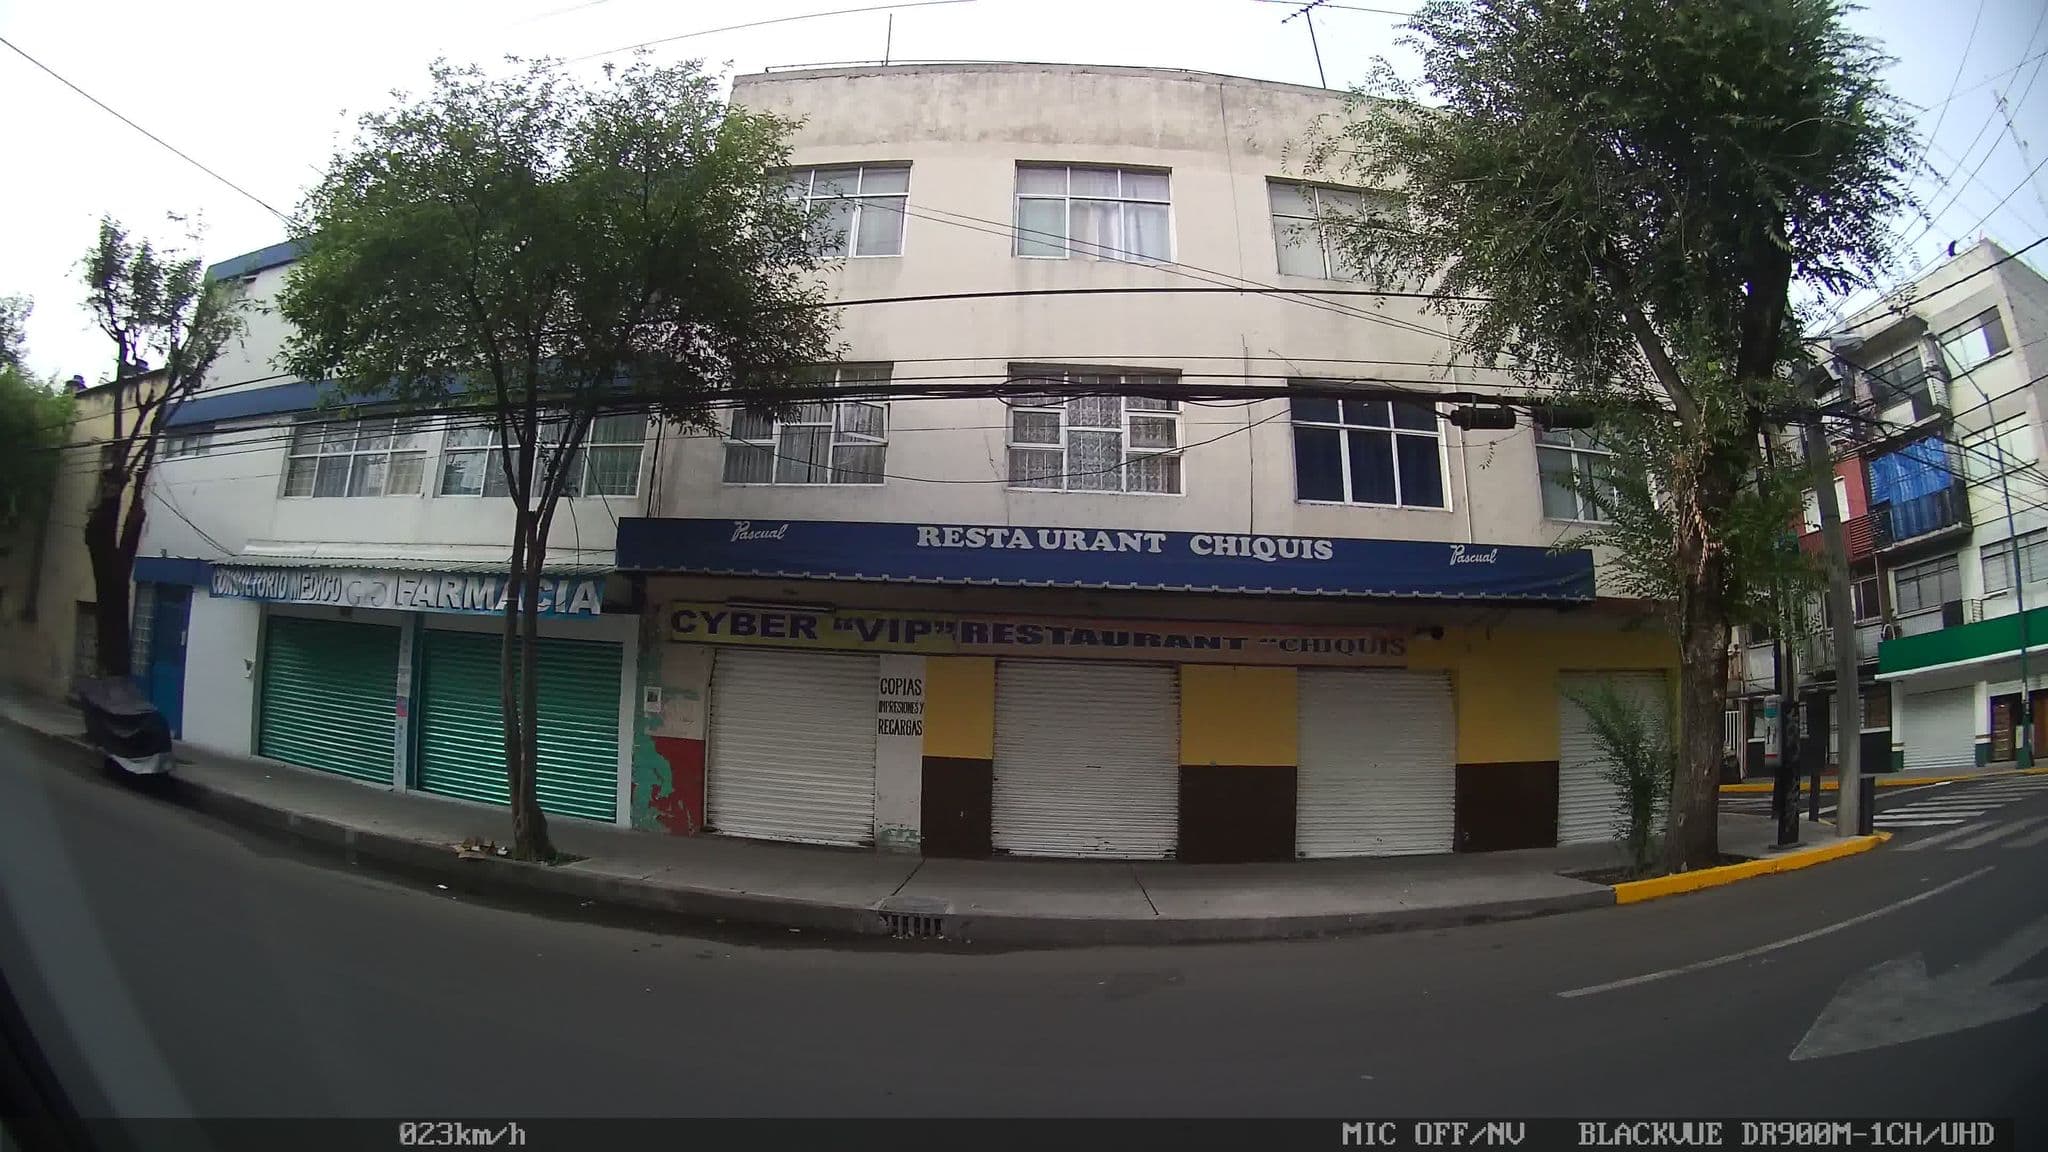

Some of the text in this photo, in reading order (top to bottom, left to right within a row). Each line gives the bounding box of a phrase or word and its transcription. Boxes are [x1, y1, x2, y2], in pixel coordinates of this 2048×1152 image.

[730, 520, 789, 542] Pascual
[916, 526, 1334, 562] RESTAURANT CHIQUIS
[1449, 544, 1498, 566] Pascual
[211, 567, 288, 600] CONSULTORIO
[670, 609, 817, 640] CYBER
[960, 621, 1248, 650] RESTAURANT
[880, 678, 922, 696] COPIAS
[878, 700, 919, 714] IMPRESIONES
[878, 718, 923, 737] RECARGAS
